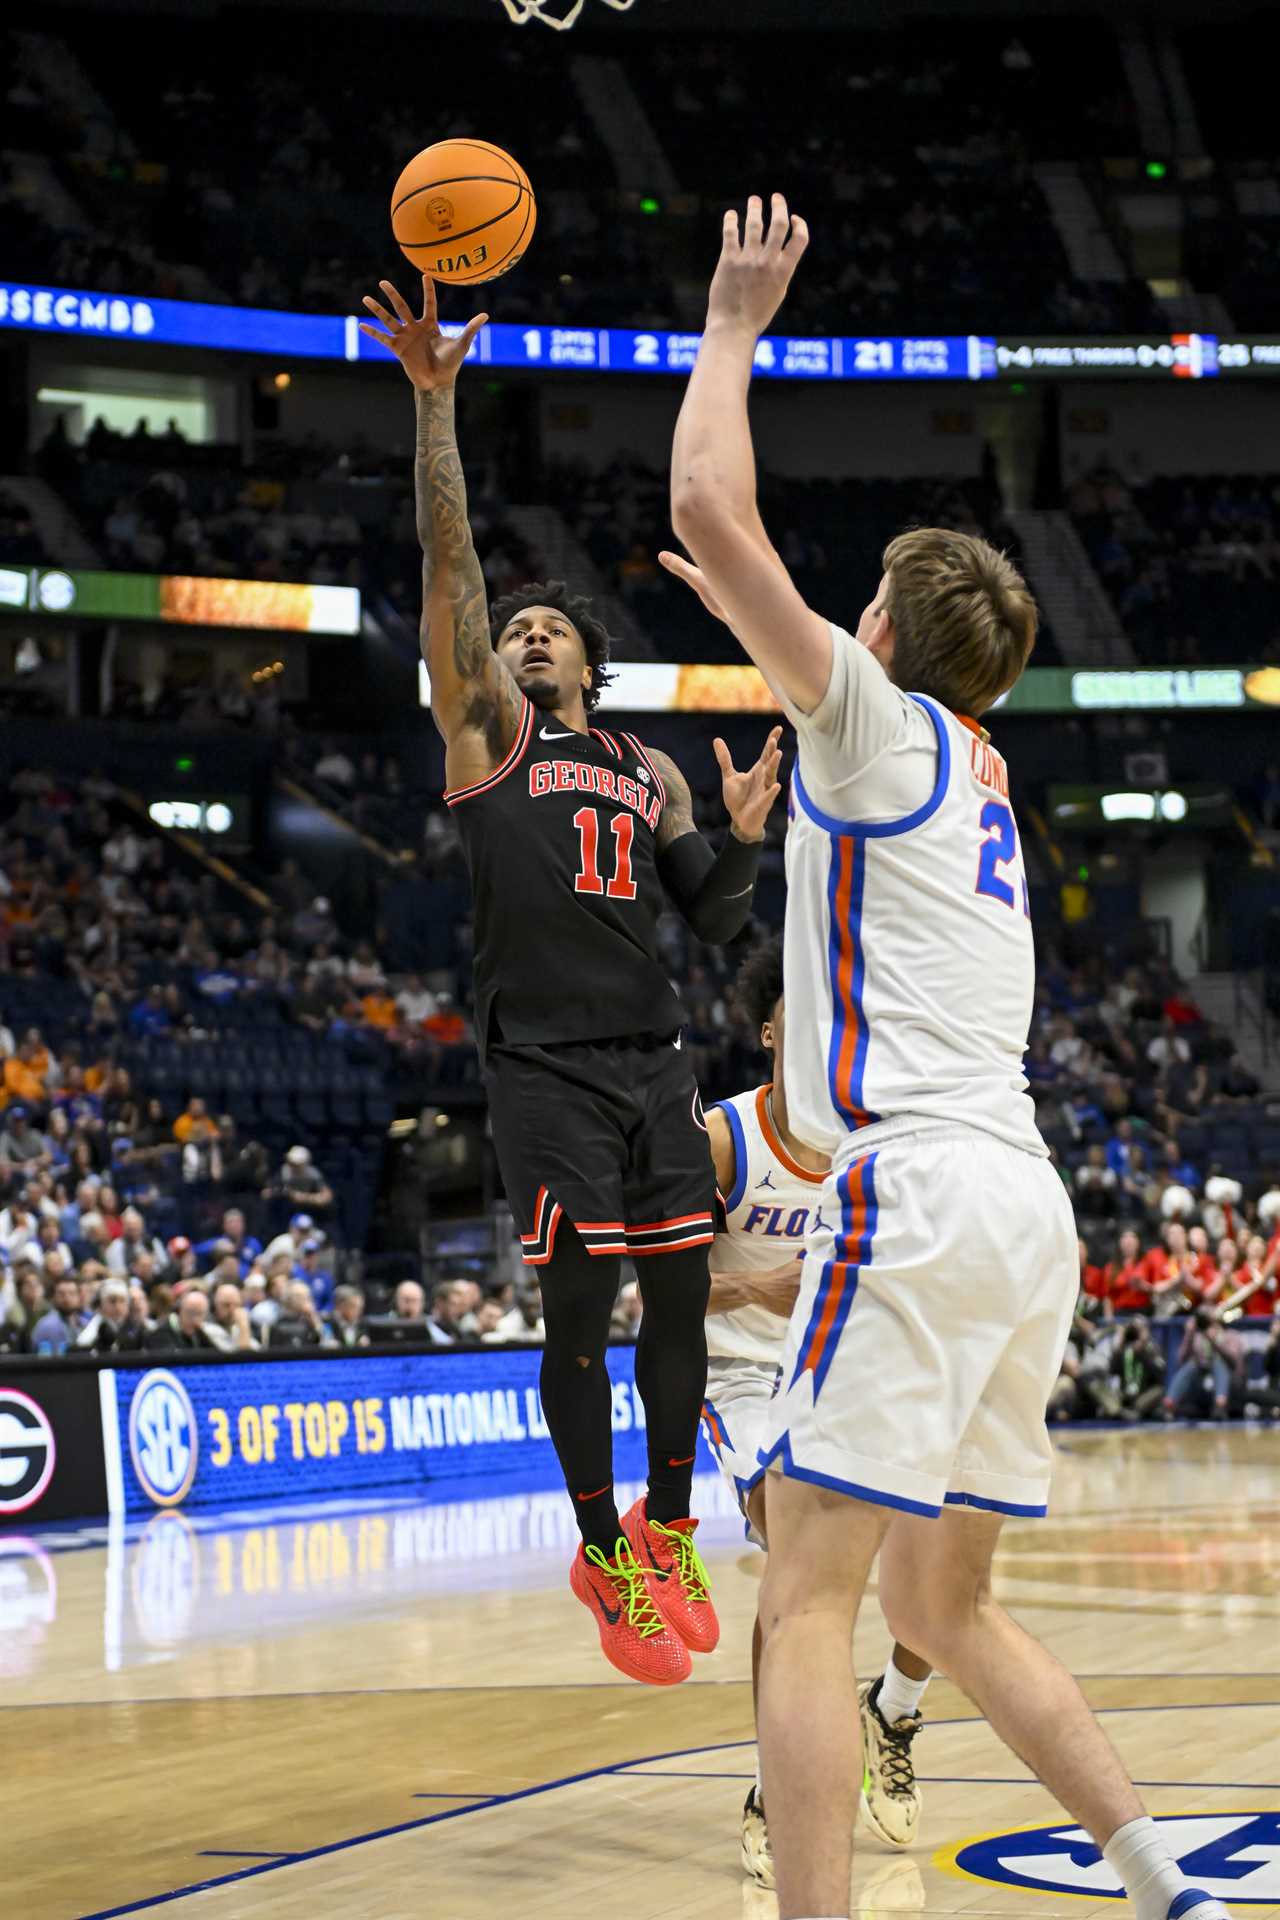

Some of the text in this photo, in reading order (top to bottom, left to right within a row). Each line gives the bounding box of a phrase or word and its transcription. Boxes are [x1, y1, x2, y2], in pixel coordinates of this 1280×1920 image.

[437, 245, 488, 273] EVO
[523, 330, 542, 359] 1
[633, 334, 659, 364] 2
[855, 340, 893, 371] 21
[529, 760, 661, 833] GEORGIA
[573, 807, 637, 900] 11
[208, 1408, 232, 1467] 3
[238, 1404, 280, 1464] OF
[284, 1400, 348, 1461] TOP
[352, 1397, 386, 1454] 15
[389, 1388, 527, 1451] NATIONAL
